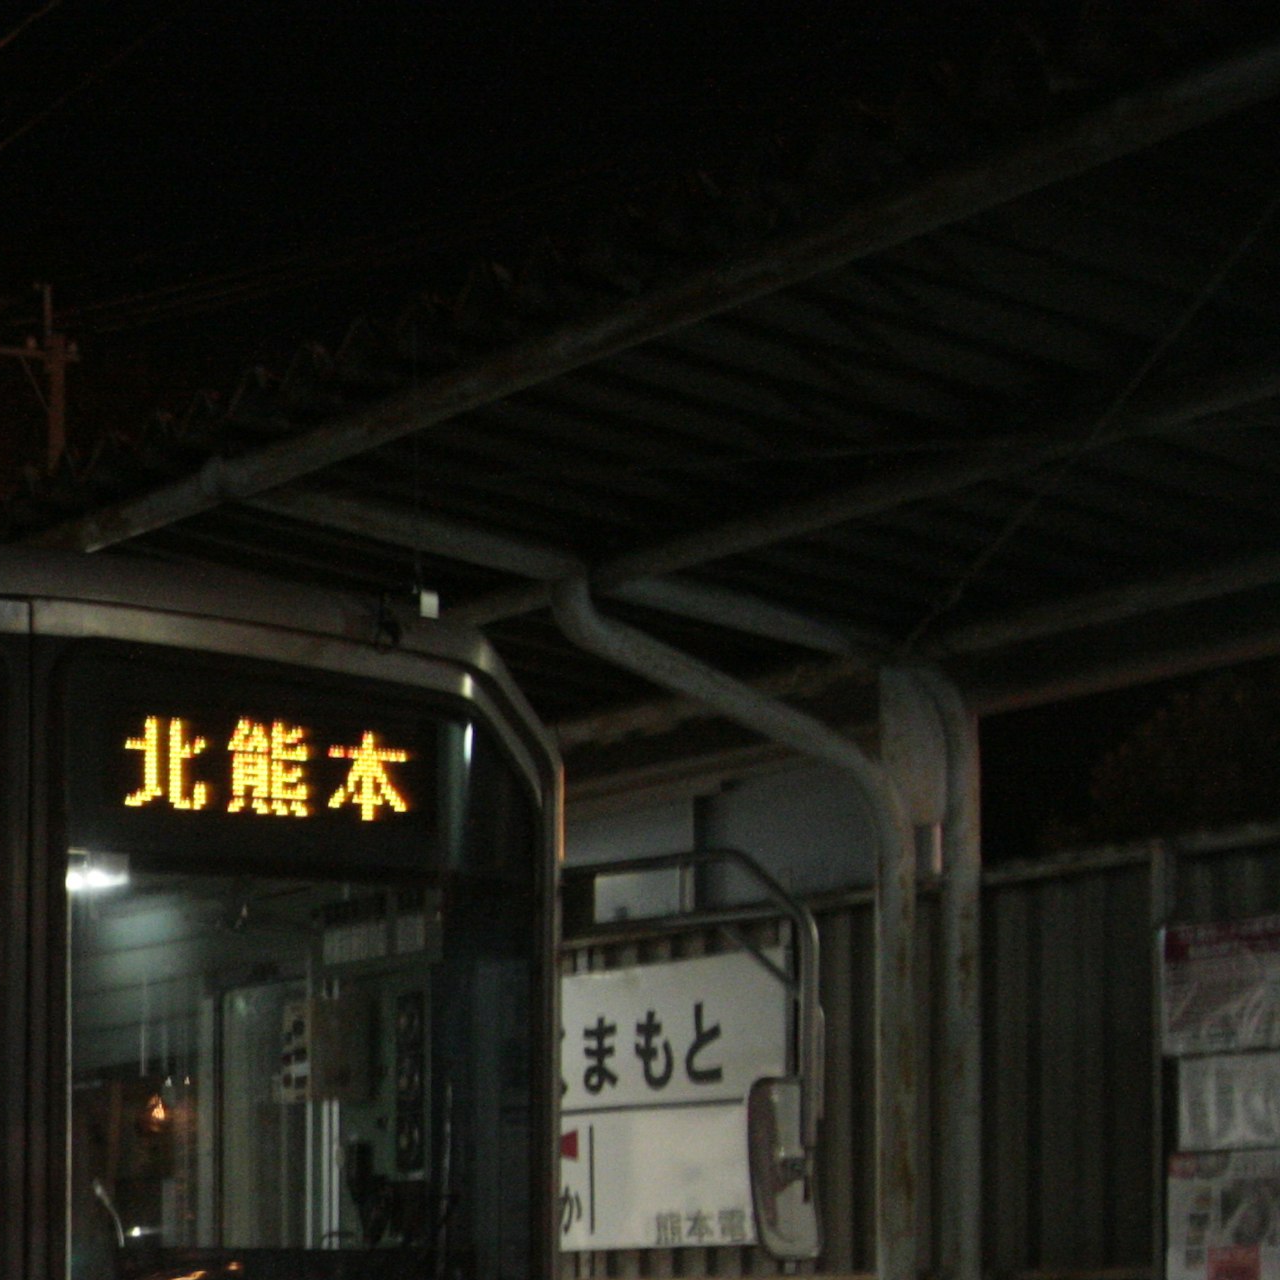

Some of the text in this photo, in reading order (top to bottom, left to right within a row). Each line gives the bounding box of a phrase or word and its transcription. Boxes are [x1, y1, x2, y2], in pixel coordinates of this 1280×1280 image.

[124, 715, 409, 822] 北熊本
[560, 1002, 723, 1093] まもと
